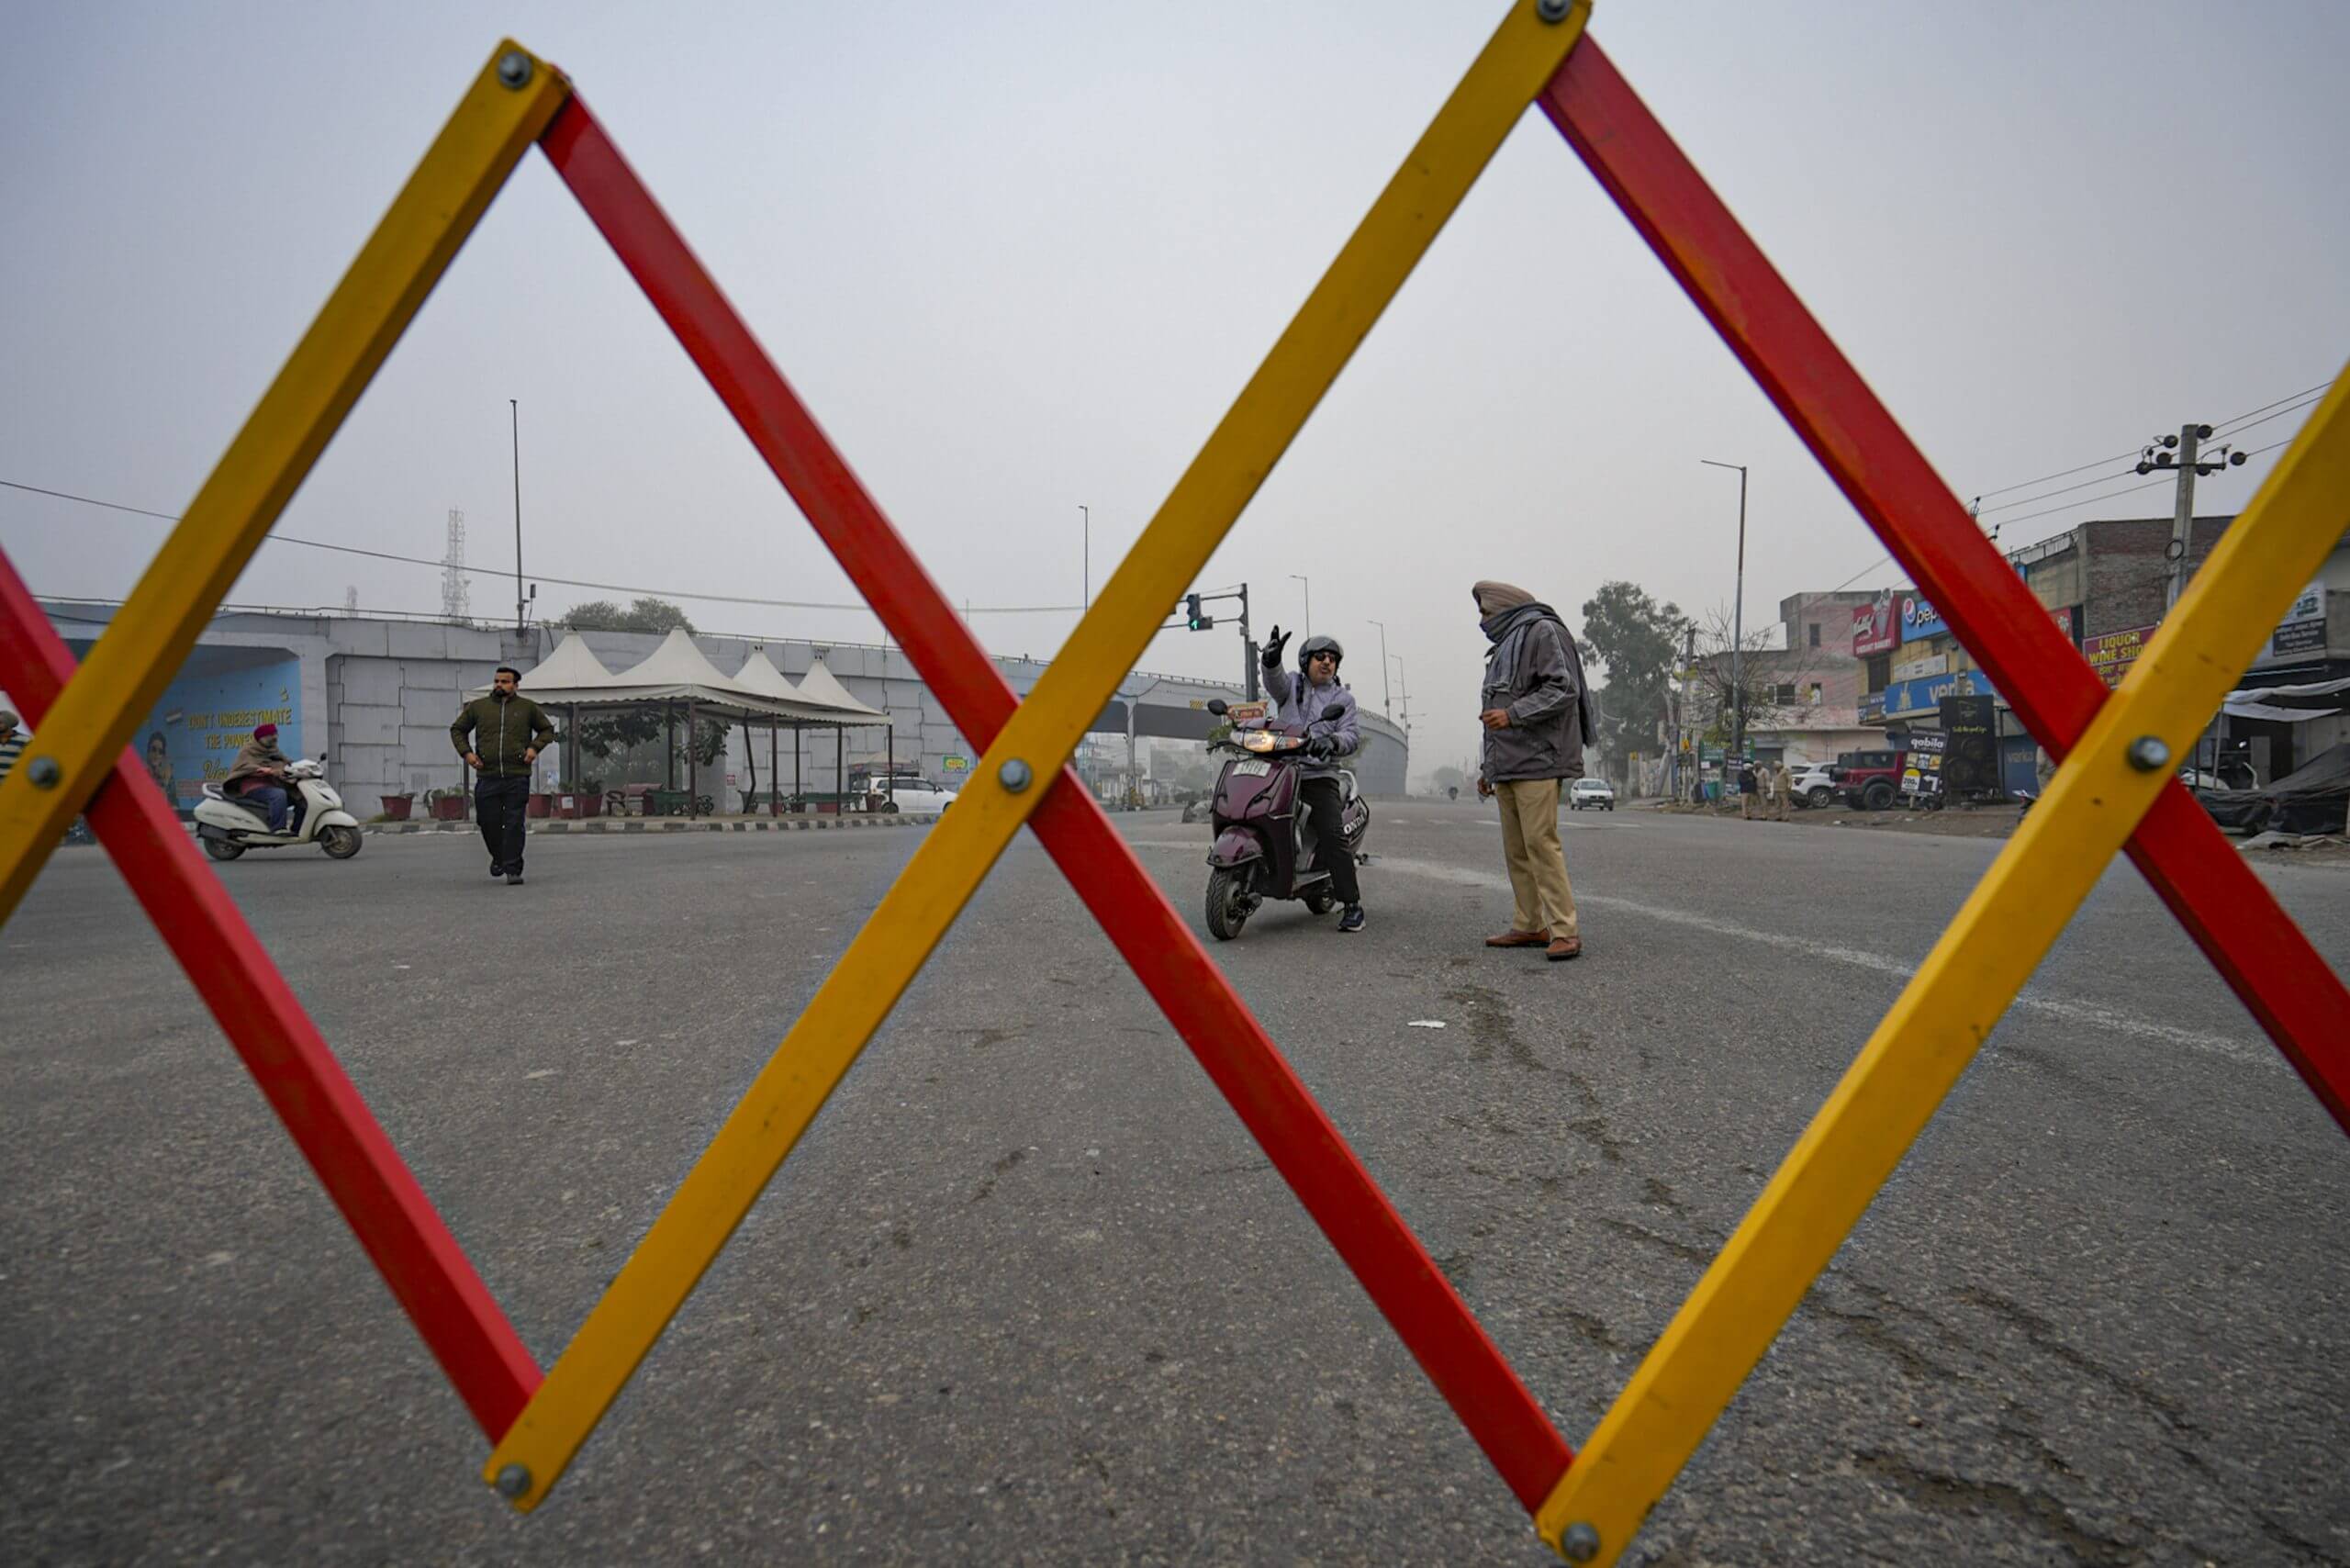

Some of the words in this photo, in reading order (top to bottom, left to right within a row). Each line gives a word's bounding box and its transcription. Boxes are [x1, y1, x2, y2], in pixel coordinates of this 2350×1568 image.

[1916, 607, 1941, 628] pep
[2098, 631, 2141, 650] LIQUOR
[2088, 649, 2117, 664] WINE
[2121, 644, 2144, 659] SHO
[218, 708, 292, 727] UNDERESTIMATE
[205, 734, 221, 750] THE
[1343, 814, 1365, 834] ONDA
